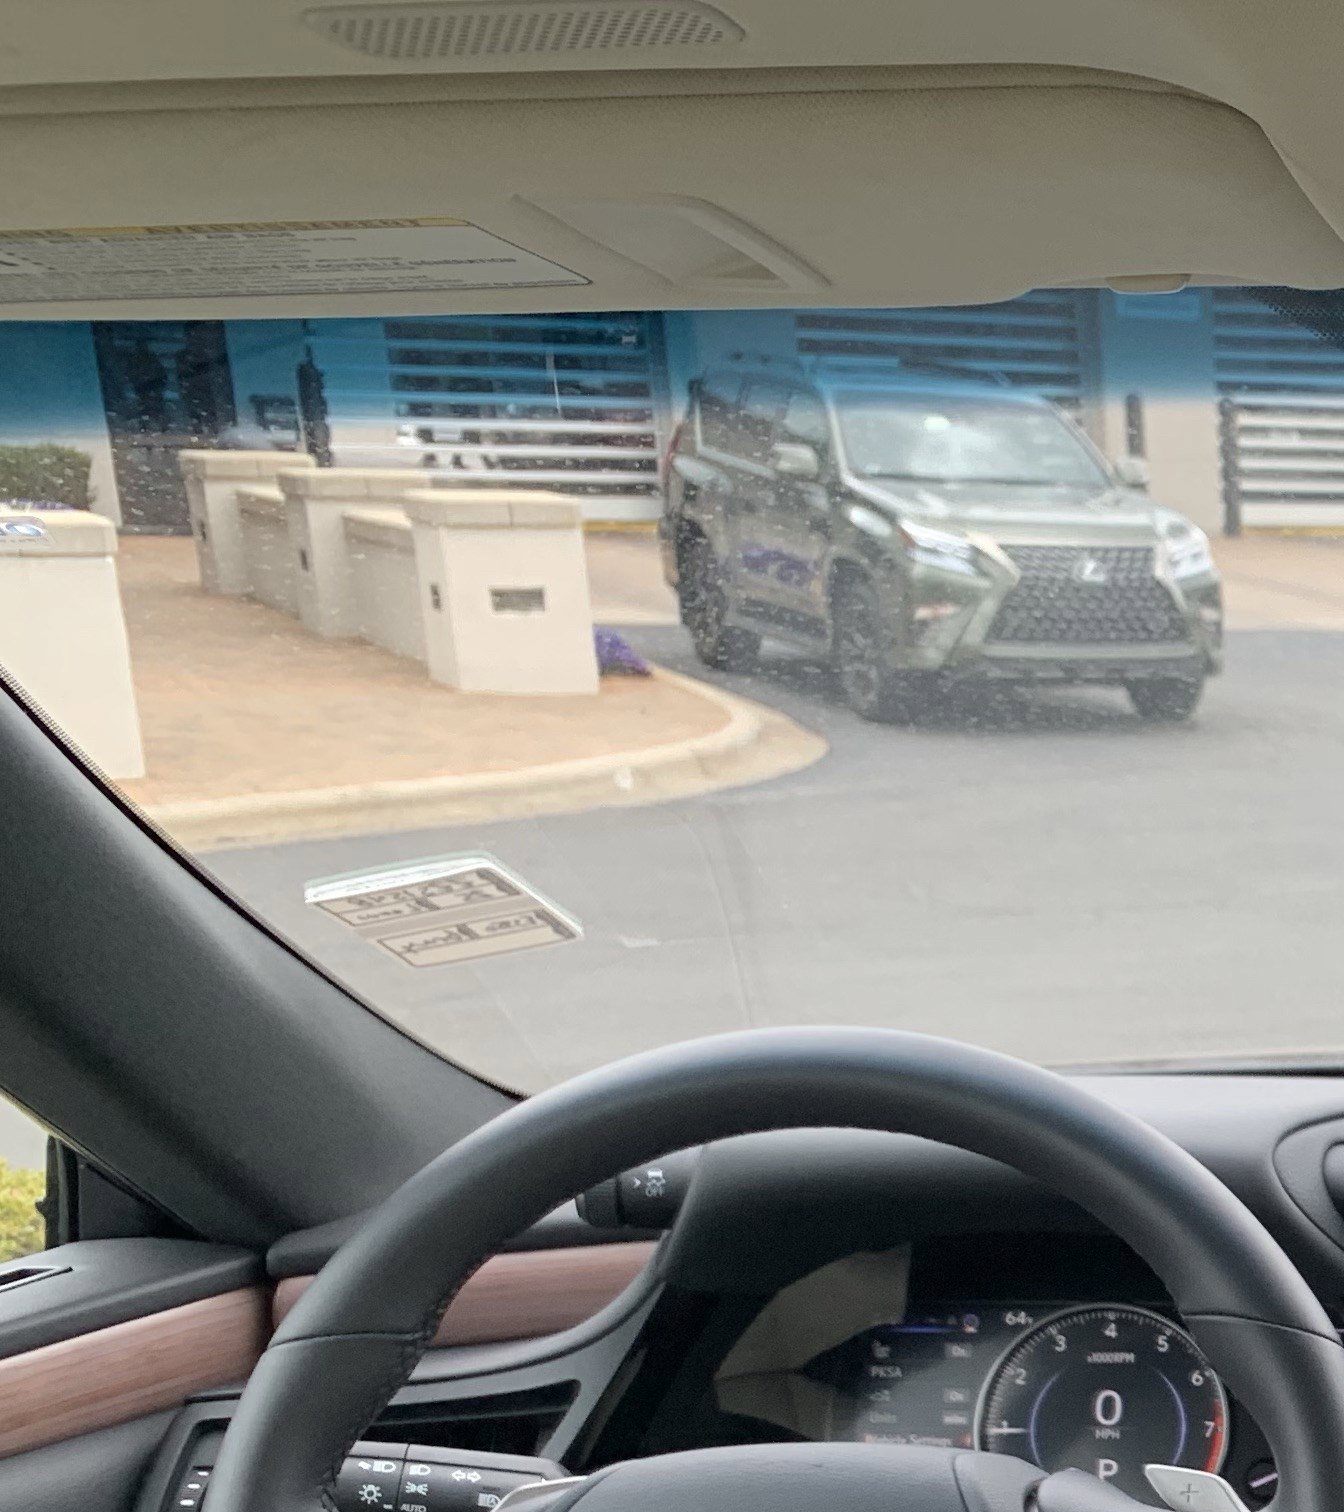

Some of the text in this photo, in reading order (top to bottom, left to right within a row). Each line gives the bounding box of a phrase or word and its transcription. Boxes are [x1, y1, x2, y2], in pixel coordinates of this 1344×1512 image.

[1104, 1322, 1119, 1339] 4
[1054, 1334, 1068, 1352] 3
[1156, 1334, 1169, 1352] 5
[1015, 1368, 1027, 1386] 2
[1190, 1369, 1204, 1387] 6
[1095, 1388, 1123, 1426] 0
[1203, 1420, 1215, 1438] 7
[1098, 1458, 1119, 1479] P
